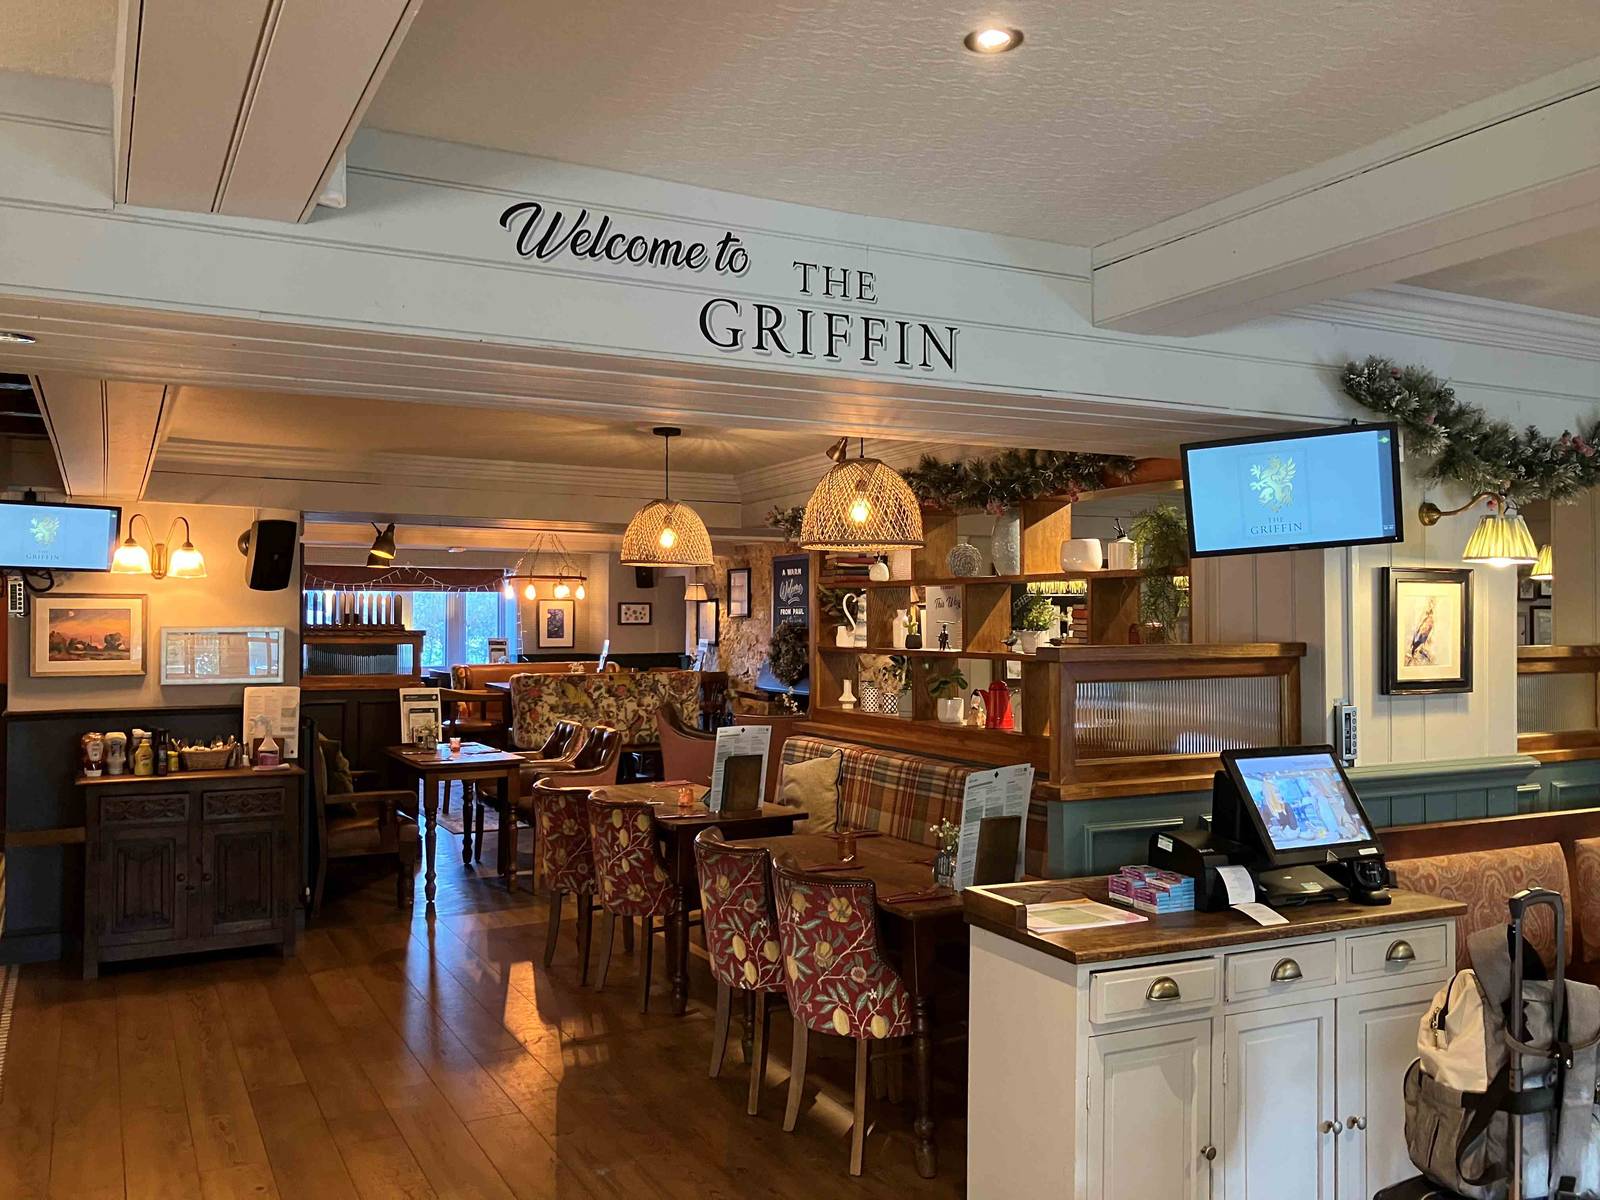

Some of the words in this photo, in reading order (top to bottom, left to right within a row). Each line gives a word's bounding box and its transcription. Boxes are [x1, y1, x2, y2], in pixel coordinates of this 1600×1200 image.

[499, 201, 709, 270] Welcome
[714, 231, 751, 276] to
[792, 261, 878, 303] THE
[699, 298, 959, 373] GRIFFIN
[1250, 522, 1303, 535] GRIFFIN
[787, 568, 802, 576] WARM
